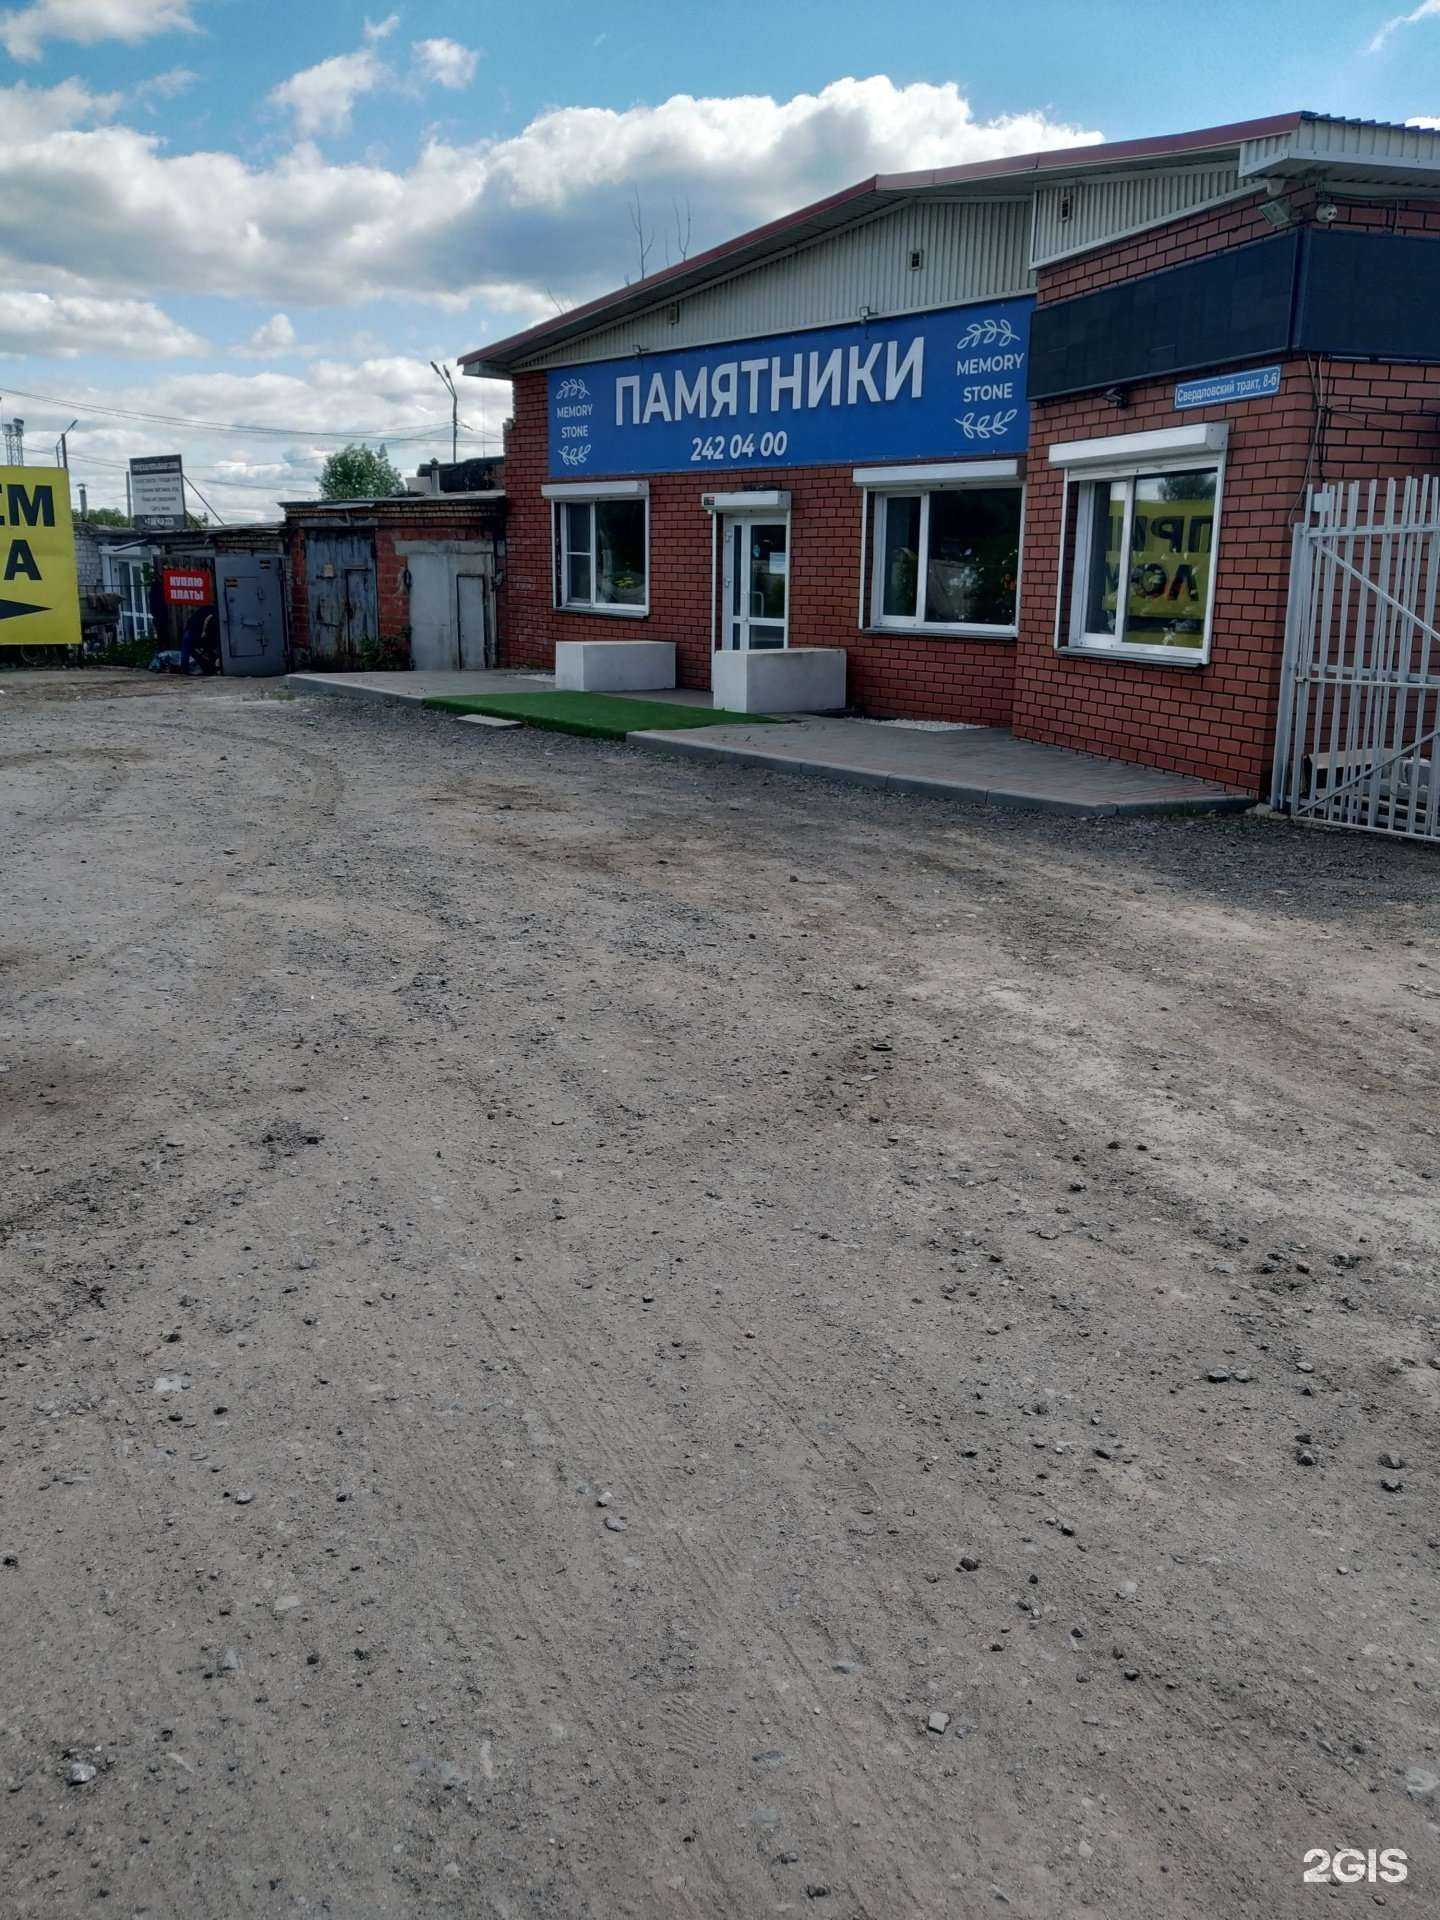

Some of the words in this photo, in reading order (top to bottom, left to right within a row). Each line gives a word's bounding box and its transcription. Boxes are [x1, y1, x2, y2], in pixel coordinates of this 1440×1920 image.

[956, 352, 1025, 377] MEMORY
[615, 336, 925, 426] ПАМЯТНИКИ
[1177, 380, 1235, 403] Свердловский
[963, 382, 1014, 402] STONE
[556, 403, 593, 419] MEMORY
[561, 424, 589, 439] STONE
[690, 437, 725, 462] 242
[729, 433, 755, 460] 04
[759, 430, 788, 457] 00
[0, 483, 56, 527] М
[169, 575, 204, 588] КУПЛЮ
[170, 589, 204, 601] ПЛАТЫ
